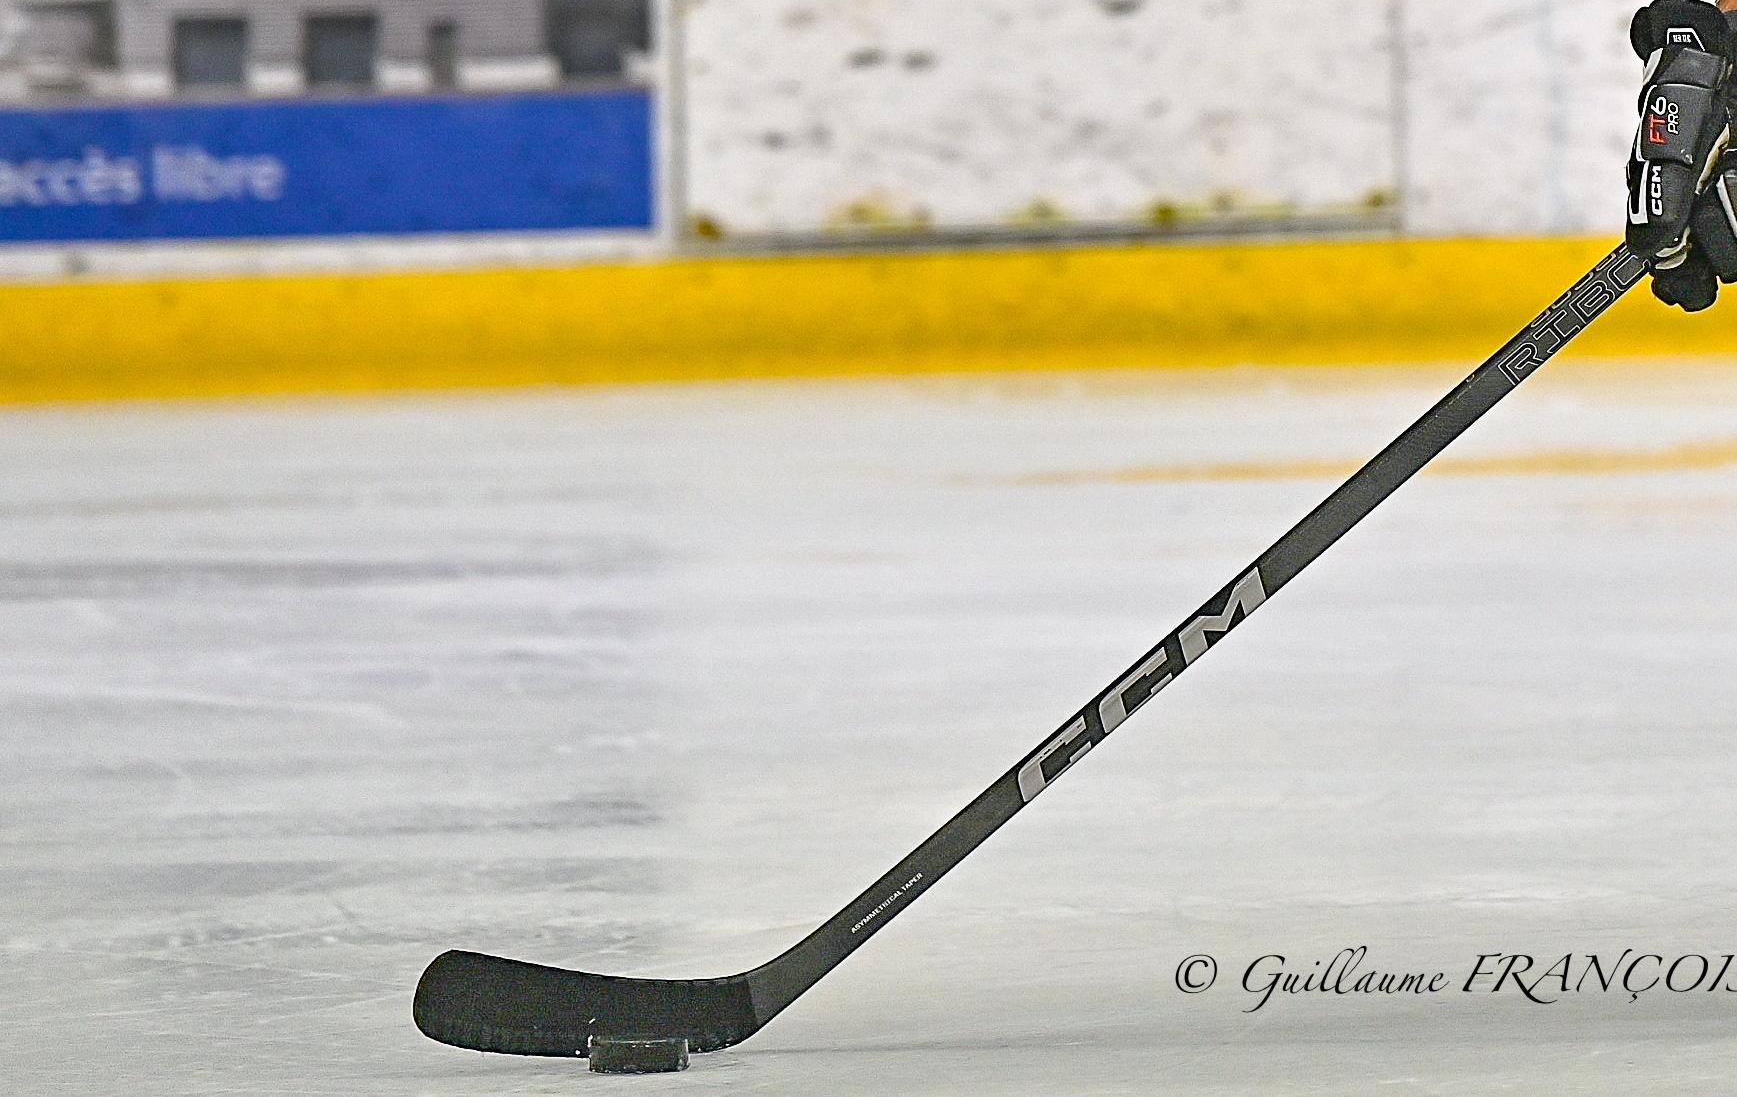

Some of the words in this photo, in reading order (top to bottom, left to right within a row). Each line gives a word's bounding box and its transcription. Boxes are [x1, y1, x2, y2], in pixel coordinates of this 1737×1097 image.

[1667, 102, 1680, 135] PRO
[1650, 165, 1664, 216] CCM
[1497, 252, 1651, 386] RIBC
[1016, 565, 1267, 803] CCM
[851, 890, 904, 934] ASYMMETRICAL
[901, 872, 923, 891] TAPER
